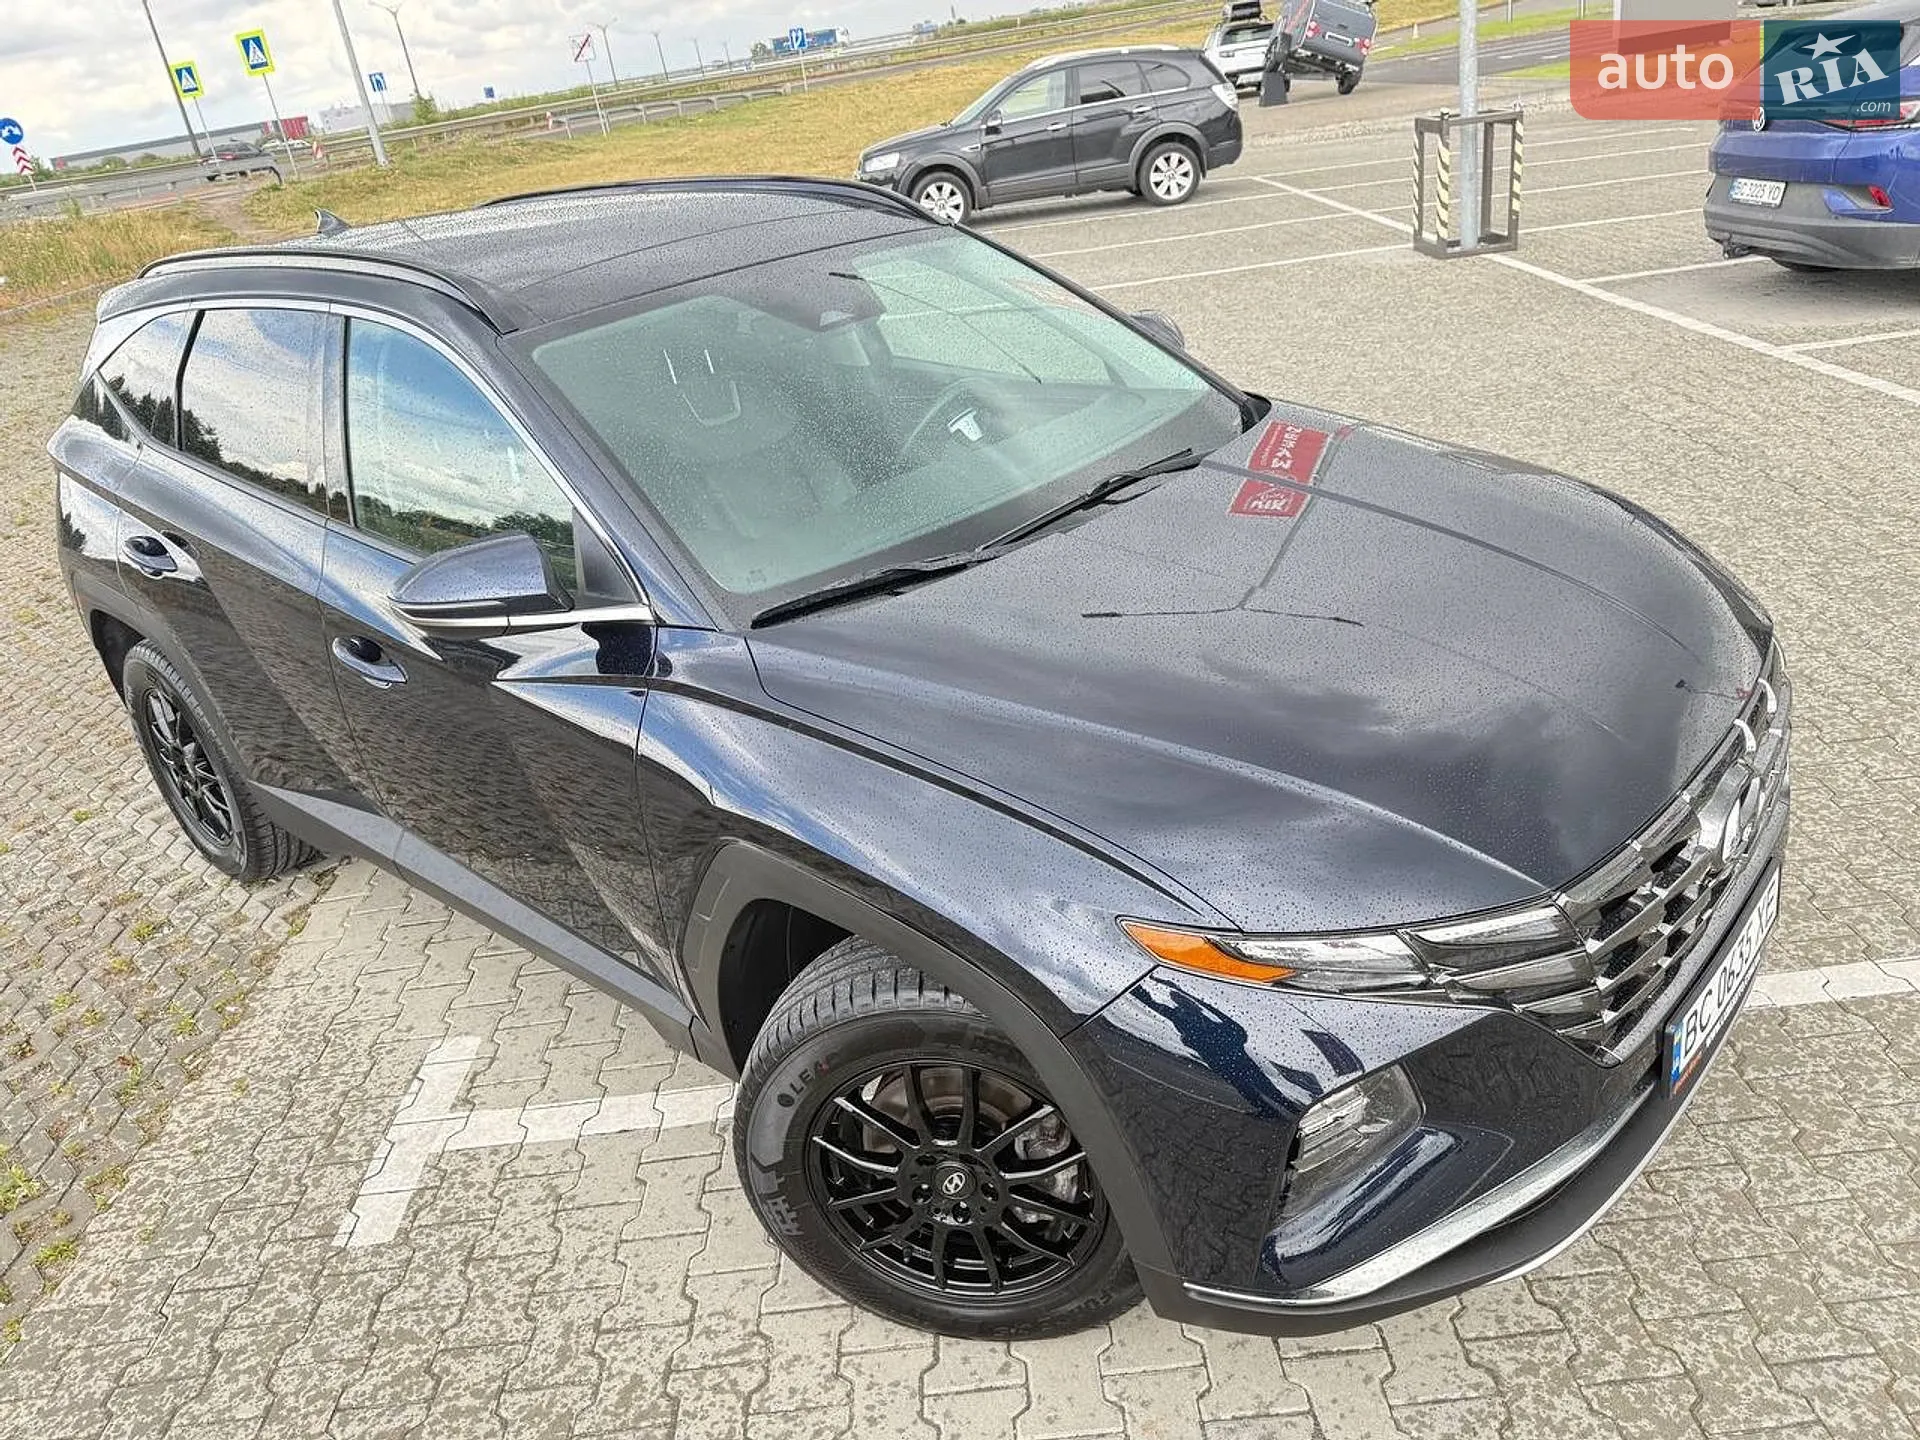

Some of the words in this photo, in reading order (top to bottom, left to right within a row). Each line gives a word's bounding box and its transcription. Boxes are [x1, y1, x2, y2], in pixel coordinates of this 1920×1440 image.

[1683, 988, 1713, 1059] BC
[1717, 920, 1752, 1010] 0635
[1754, 878, 1777, 946] XE
